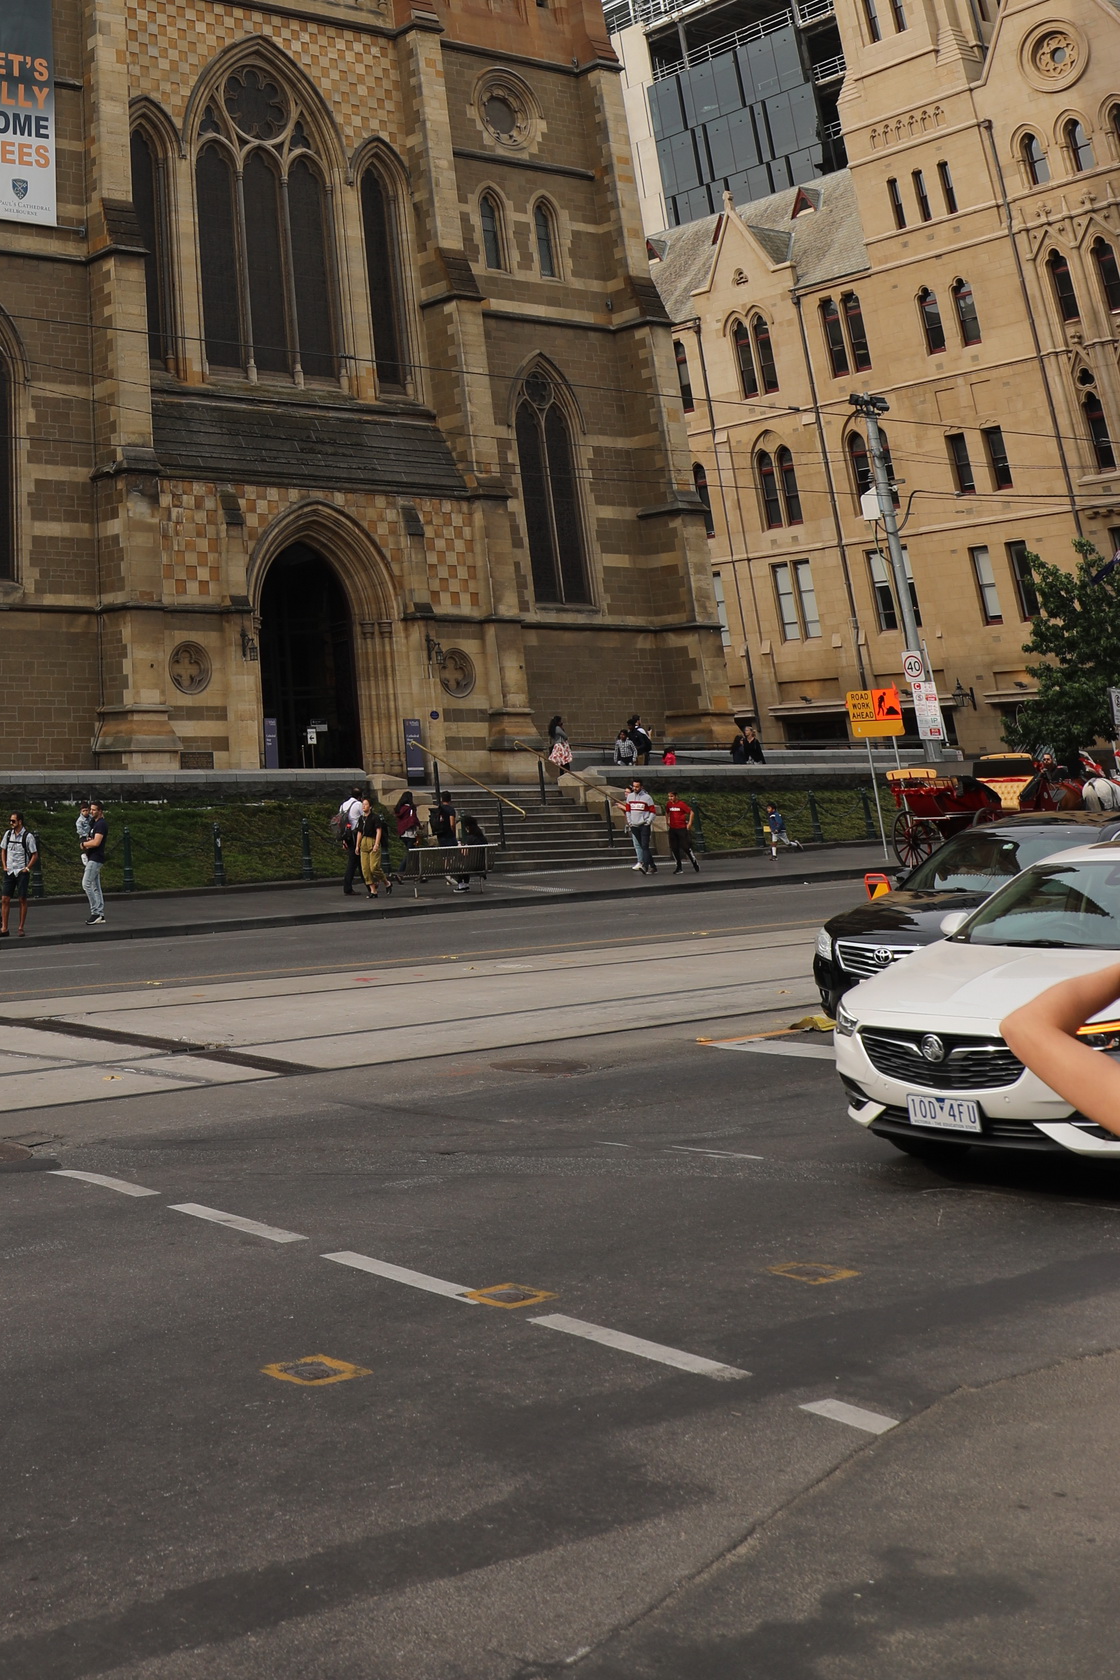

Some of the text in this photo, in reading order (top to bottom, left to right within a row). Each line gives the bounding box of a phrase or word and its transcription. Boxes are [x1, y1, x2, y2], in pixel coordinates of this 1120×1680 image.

[4, 208, 38, 216] MELBOURNE
[907, 660, 920, 672] 40
[850, 693, 869, 701] ROAD
[851, 702, 871, 710] WORK
[851, 711, 875, 719] AHEAD
[948, 1103, 976, 1124] 4FU
